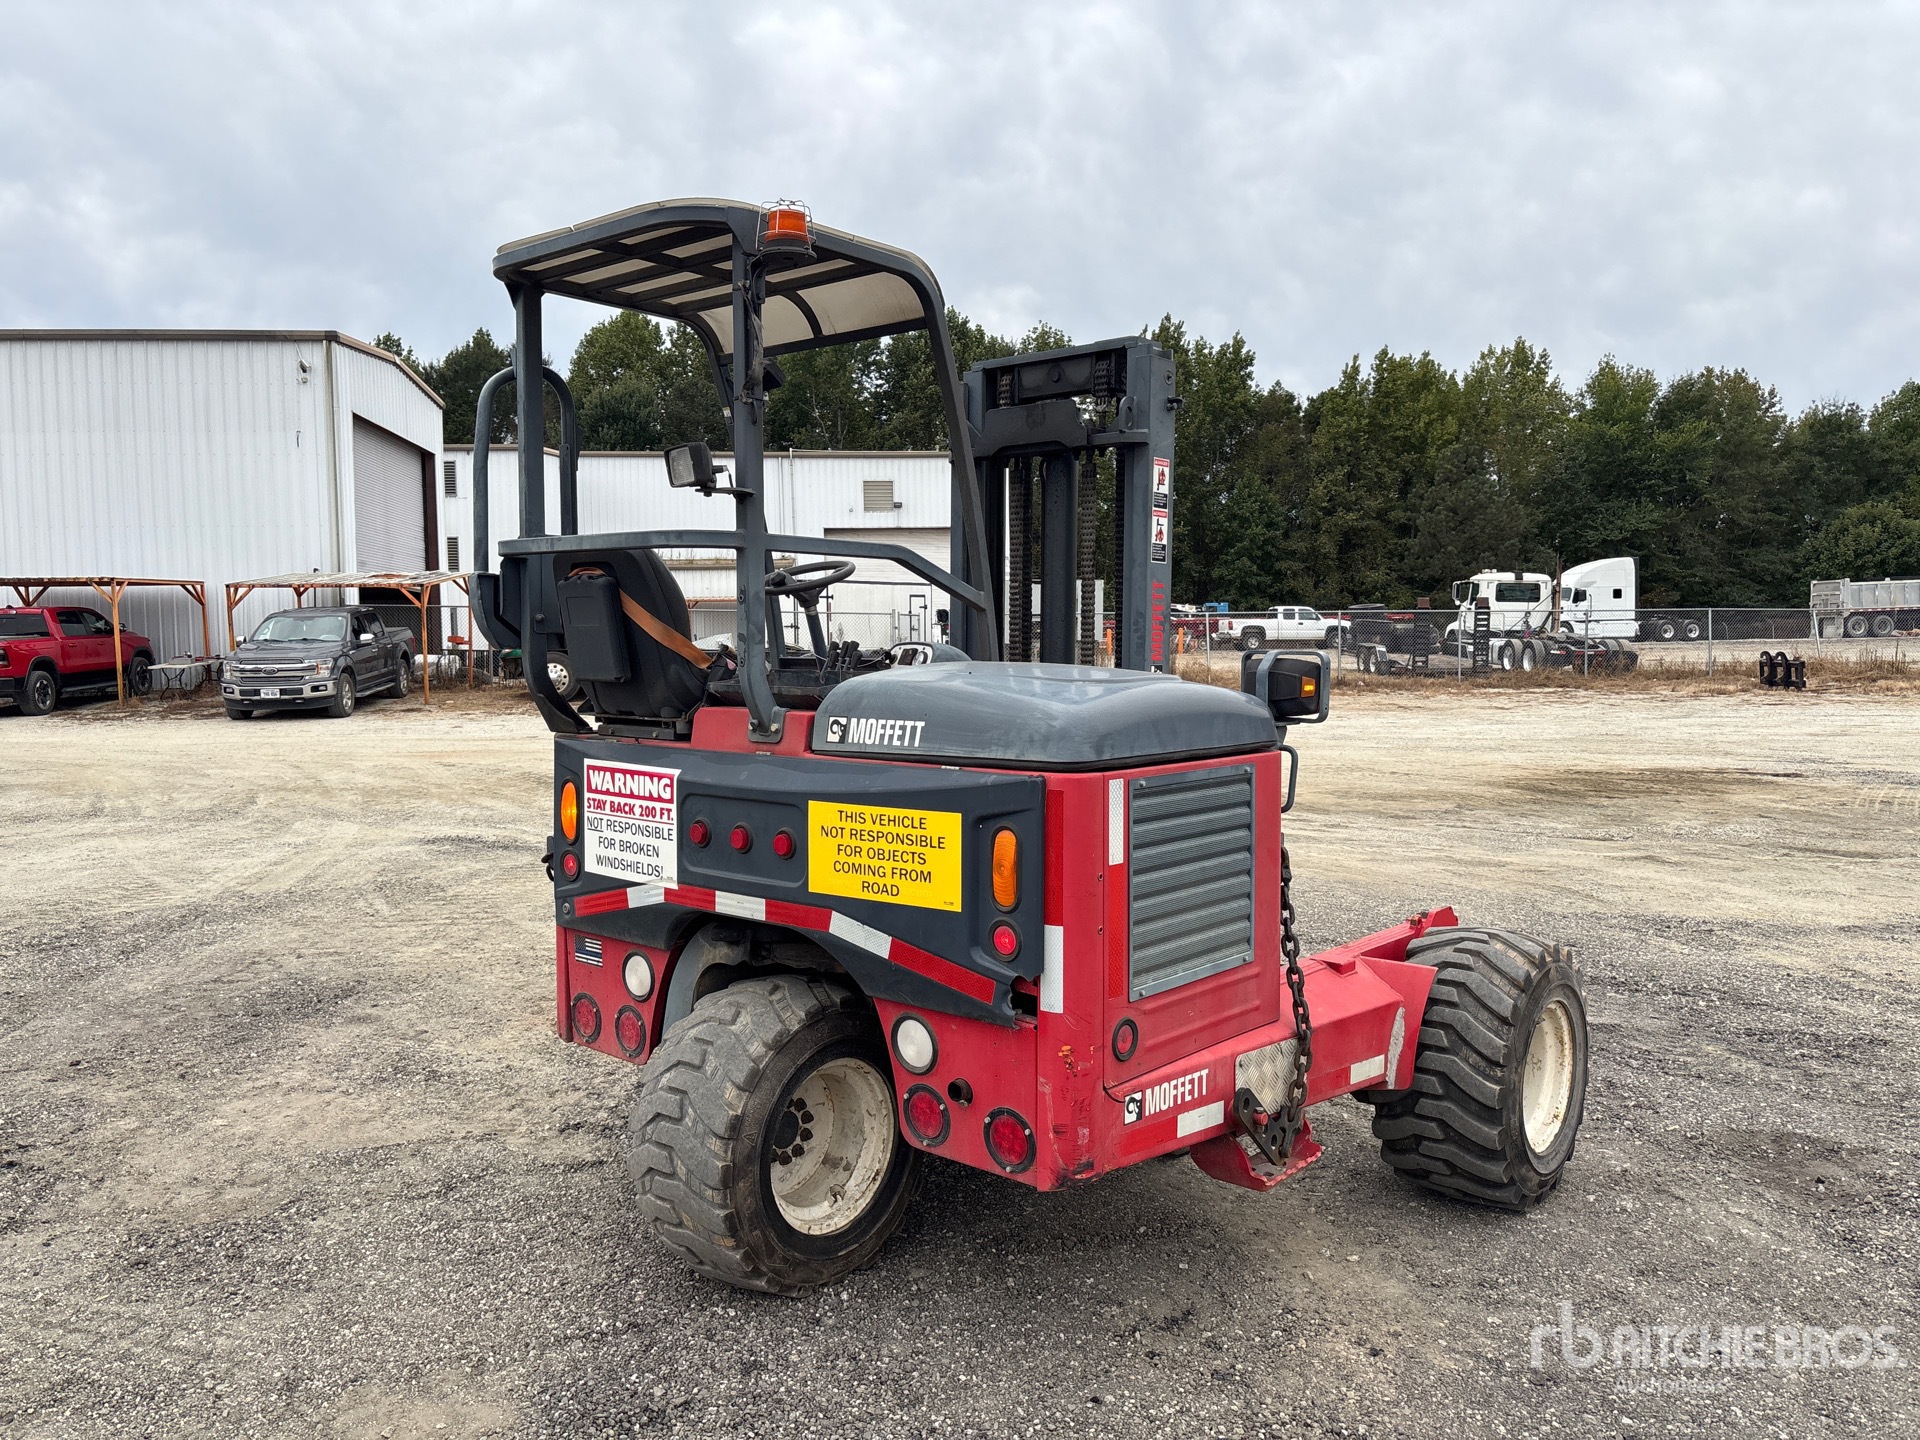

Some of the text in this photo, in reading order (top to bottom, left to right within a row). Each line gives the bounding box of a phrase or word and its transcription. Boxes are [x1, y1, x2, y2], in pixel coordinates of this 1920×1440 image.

[1151, 580, 1165, 661] MOFFETT
[848, 717, 926, 747] MOFFETT
[588, 769, 672, 800] WARNING
[586, 797, 674, 821] STAY BACK 200 FT.
[837, 809, 928, 830] THIS VEHICLE
[586, 815, 674, 841] NOT RESPONSIBLE
[820, 825, 946, 849] NOT RESPONSIBLE
[598, 836, 660, 858] FOR BROKEN
[837, 843, 927, 865] FOR OBJECTS
[595, 853, 664, 880] WINDSHIELDS!
[833, 860, 932, 883] COMING FROM
[861, 880, 900, 897] ROAD
[1145, 1068, 1209, 1117] MOFFETT
